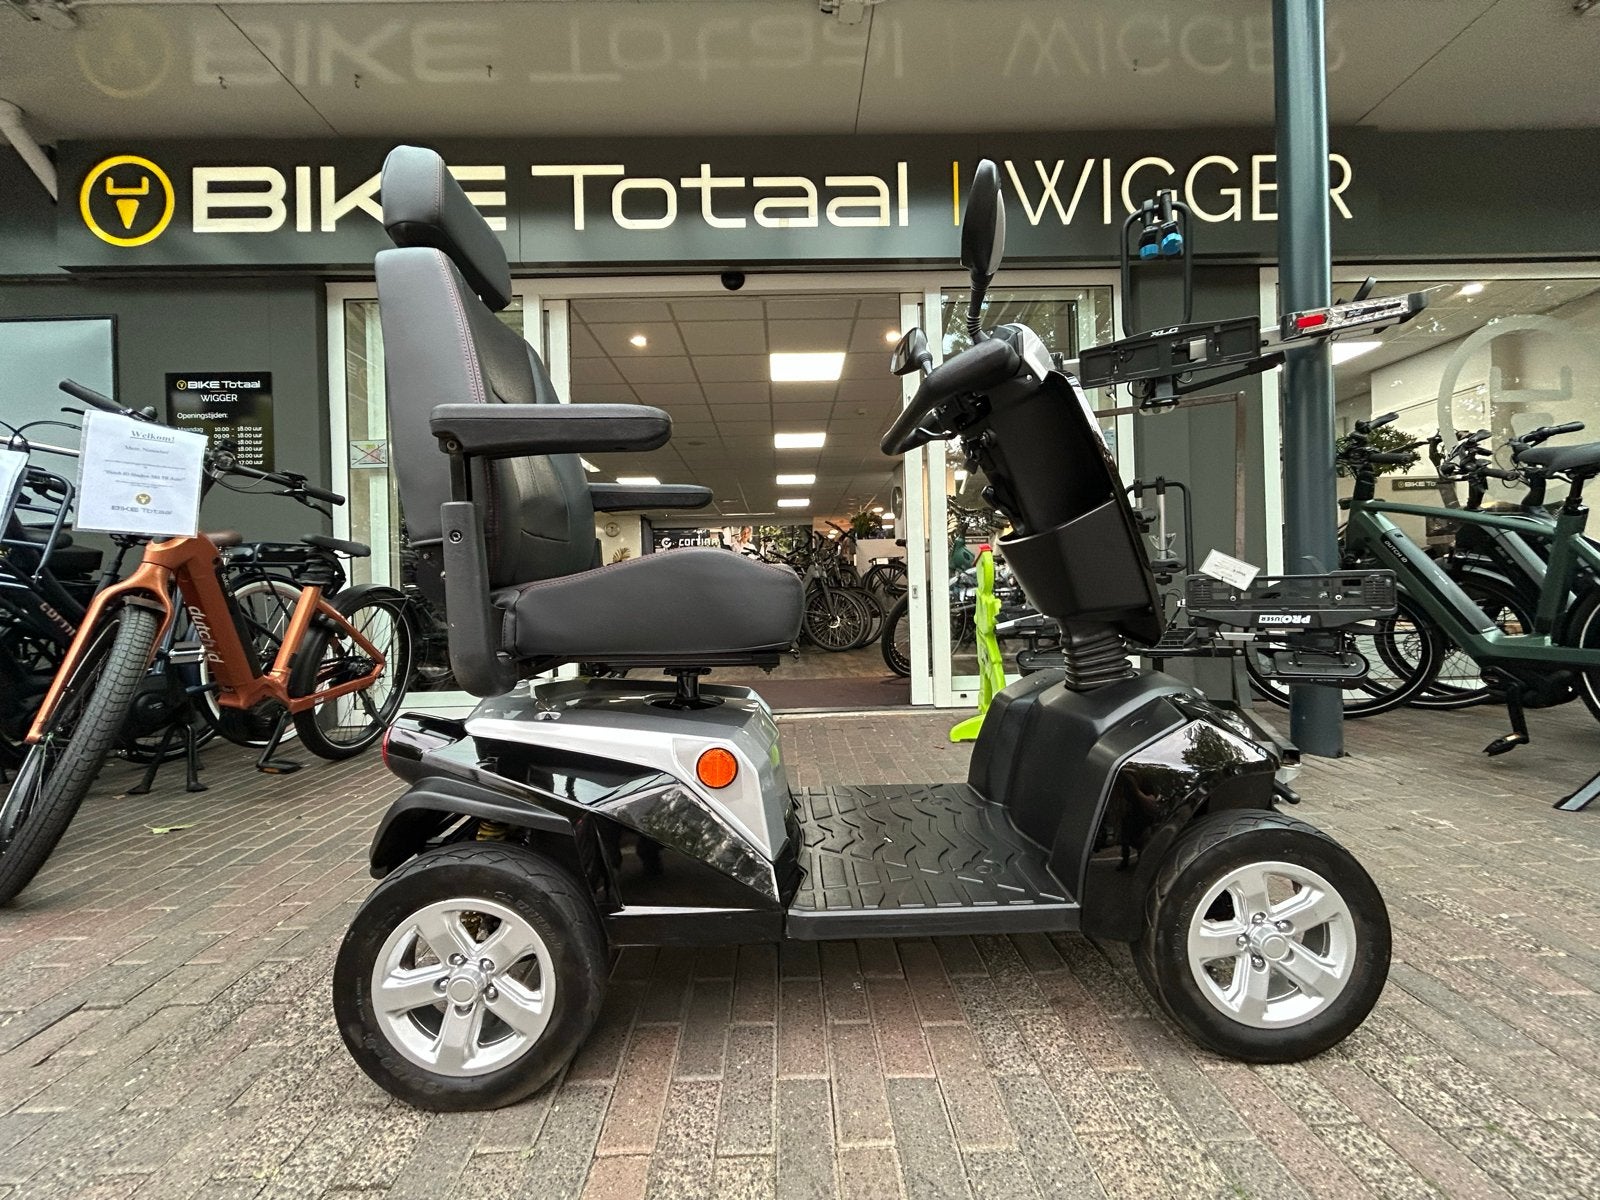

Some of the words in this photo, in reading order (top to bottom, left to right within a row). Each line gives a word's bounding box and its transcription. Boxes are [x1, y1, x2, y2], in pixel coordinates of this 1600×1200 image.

[531, 160, 909, 231] Totaal
[1004, 154, 1354, 226] WIGGER
[187, 381, 220, 389] BIKE
[221, 380, 261, 389] Totaal
[201, 394, 238, 402] WIGGER
[177, 412, 228, 420] Openingstijden:
[130, 430, 175, 442] Welkom!
[1384, 540, 1403, 558] DUTCH
[188, 605, 217, 648] dutch
